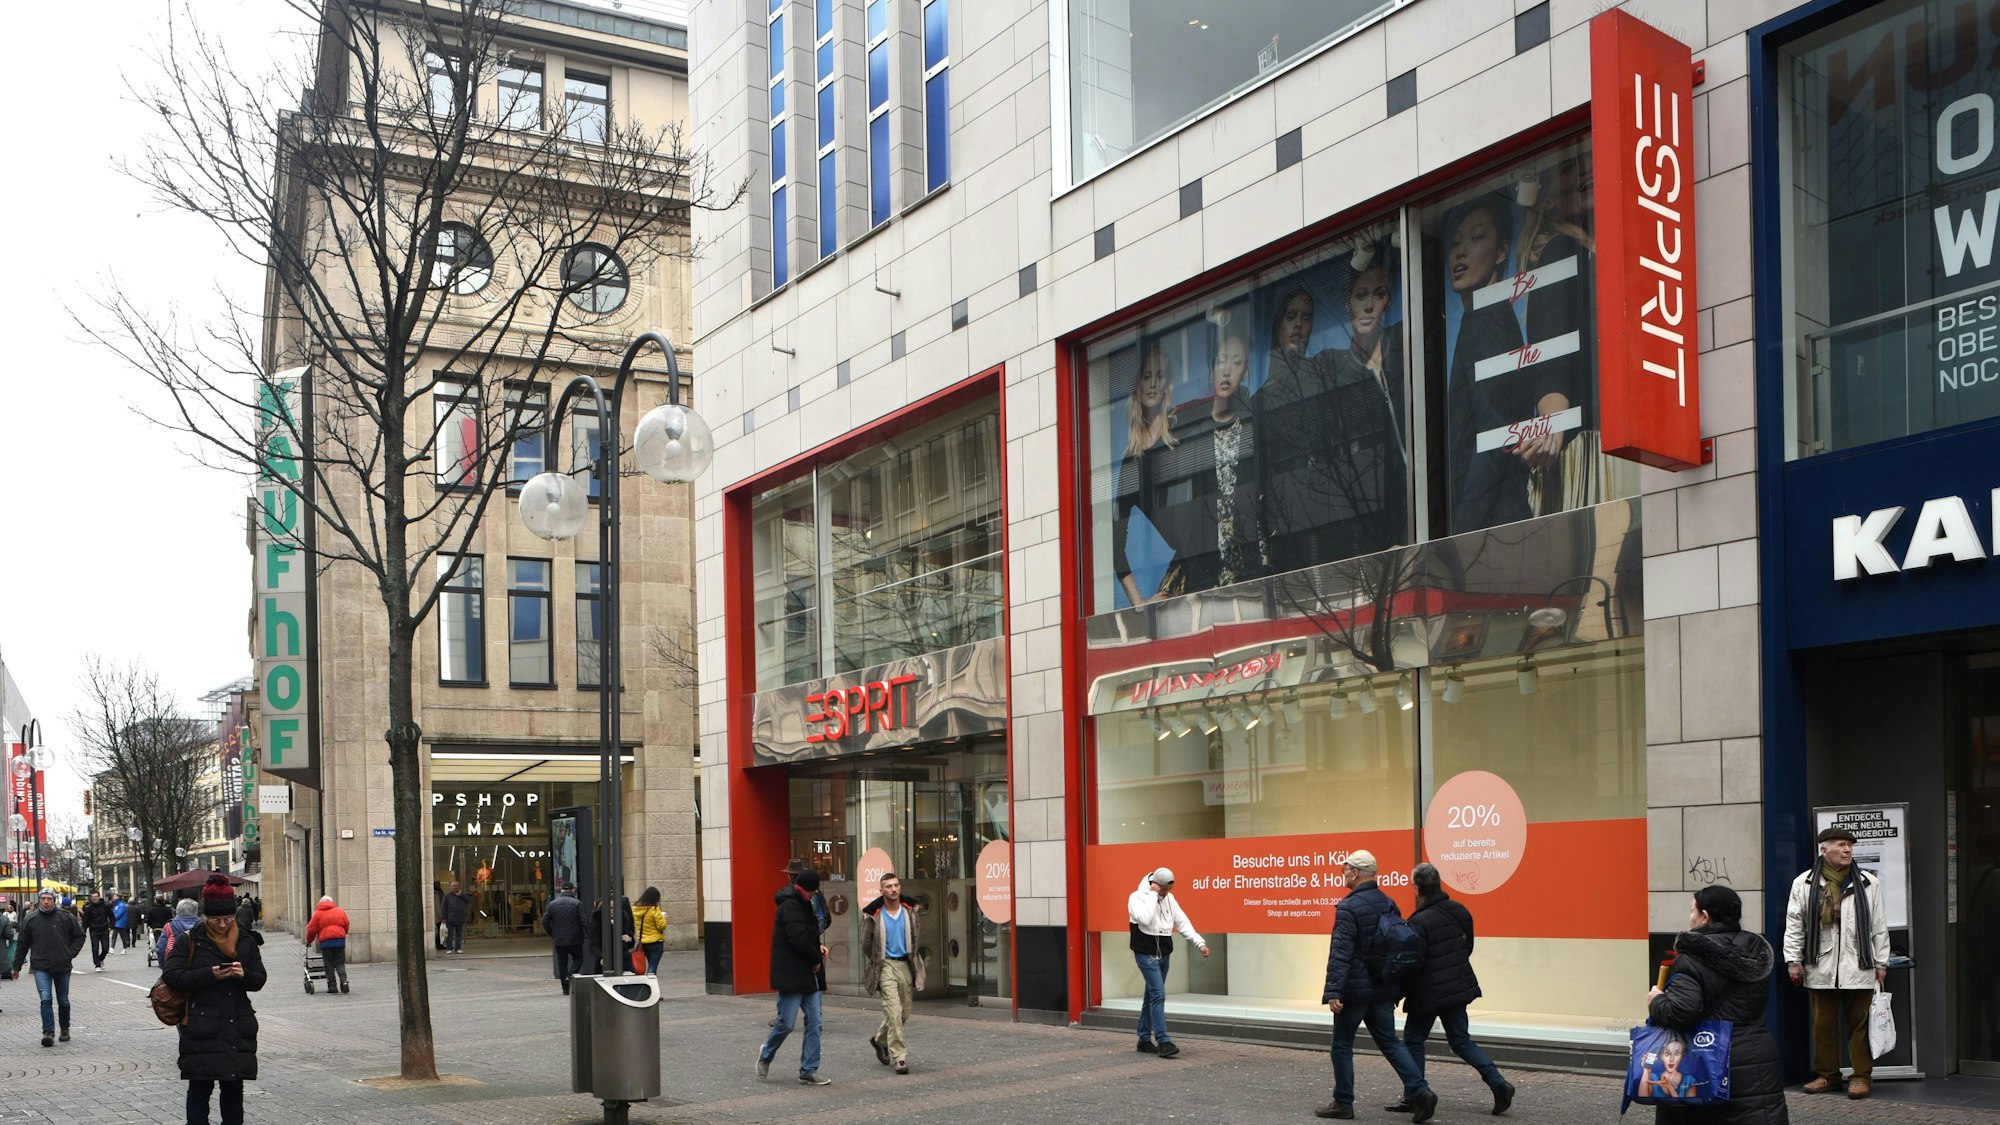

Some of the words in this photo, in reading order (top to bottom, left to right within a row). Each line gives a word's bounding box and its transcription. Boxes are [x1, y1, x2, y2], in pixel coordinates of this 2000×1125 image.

[1635, 73, 1686, 407] ESPRIT
[1509, 271, 1539, 304] Be
[1938, 295, 2000, 332] BES
[1938, 325, 1998, 361] OBE
[1509, 343, 1541, 371] The
[1939, 357, 1999, 393] NOC
[1502, 413, 1564, 453] Spirit
[804, 673, 917, 743] ESPRIT
[1447, 803, 1501, 829] 20%
[1832, 822, 1859, 830] DEINE
[1861, 821, 1889, 829] NEUEN
[1838, 812, 1882, 822] ENTDECKE
[1452, 838, 1466, 848] auf
[1468, 838, 1496, 848] bereits
[1848, 829, 1897, 838] ANGEBOTE.
[1233, 854, 1285, 869] Besuche
[1288, 855, 1310, 867] uns
[1313, 852, 1325, 866] in
[1440, 851, 1481, 861] reduzierte
[1483, 850, 1509, 859] Artikel
[1192, 876, 1209, 890] auf
[1212, 875, 1231, 889] der
[1234, 873, 1307, 888] Ehrenstraße
[1310, 873, 1320, 887] &
[1243, 898, 1262, 906] Dieser
[1262, 898, 1278, 906] Store
[1278, 898, 1301, 906] schließt
[1267, 909, 1282, 917] Shop
[1290, 909, 1321, 917] esprit.com
